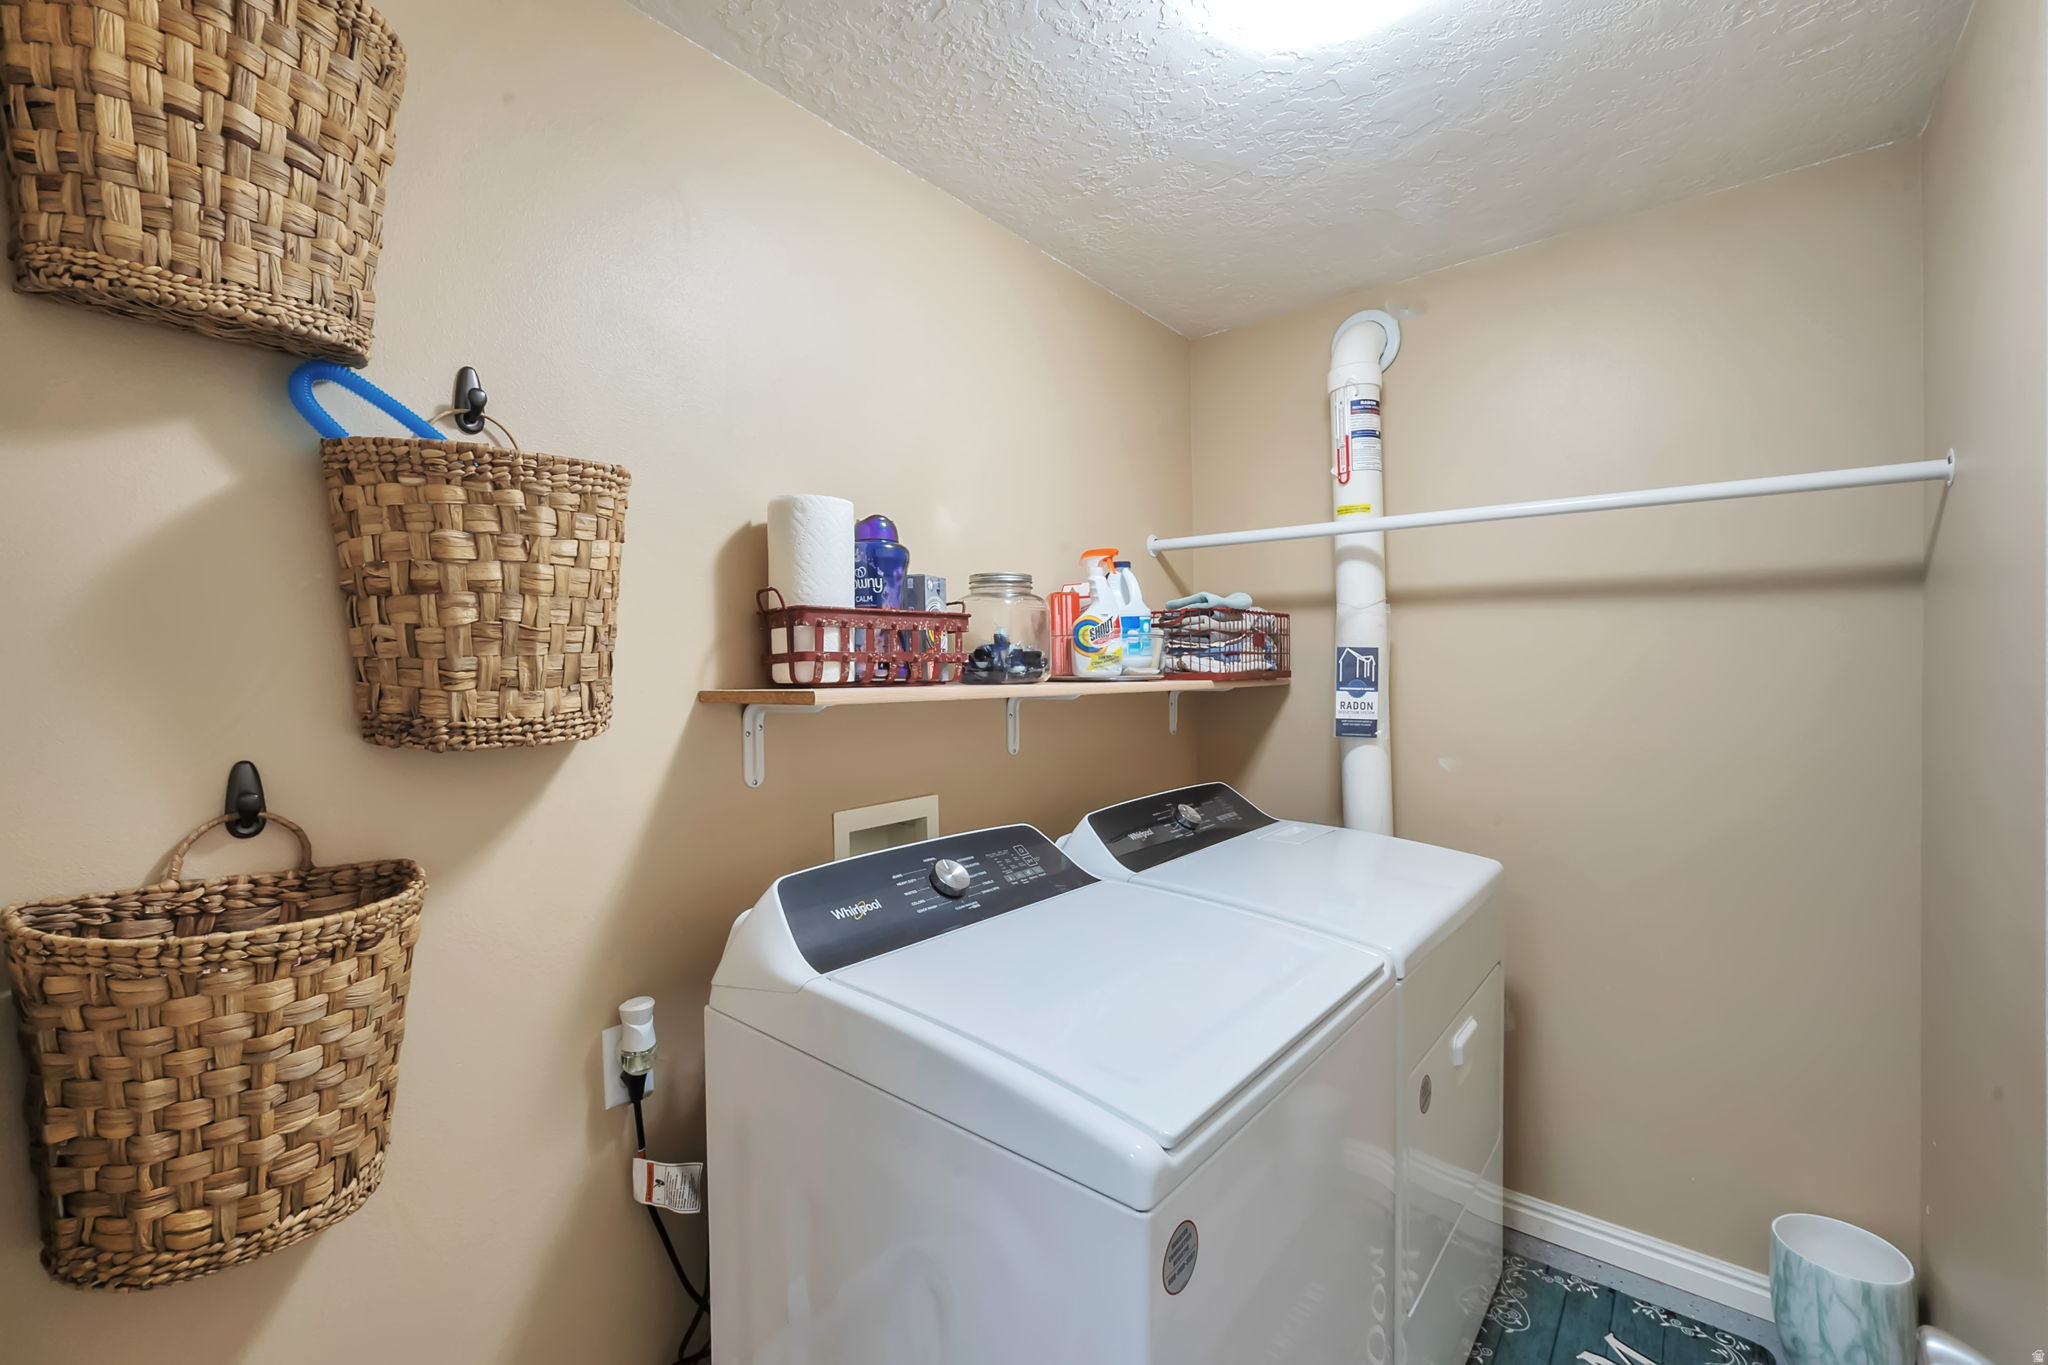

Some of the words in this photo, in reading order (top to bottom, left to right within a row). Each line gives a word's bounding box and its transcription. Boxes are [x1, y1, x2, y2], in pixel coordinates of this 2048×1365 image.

[855, 577, 883, 593] wny
[1089, 615, 1114, 641] SHOUT
[1340, 701, 1374, 710] RADON
[1127, 828, 1154, 841] Whirlpool
[830, 898, 882, 919] Whirlpool
